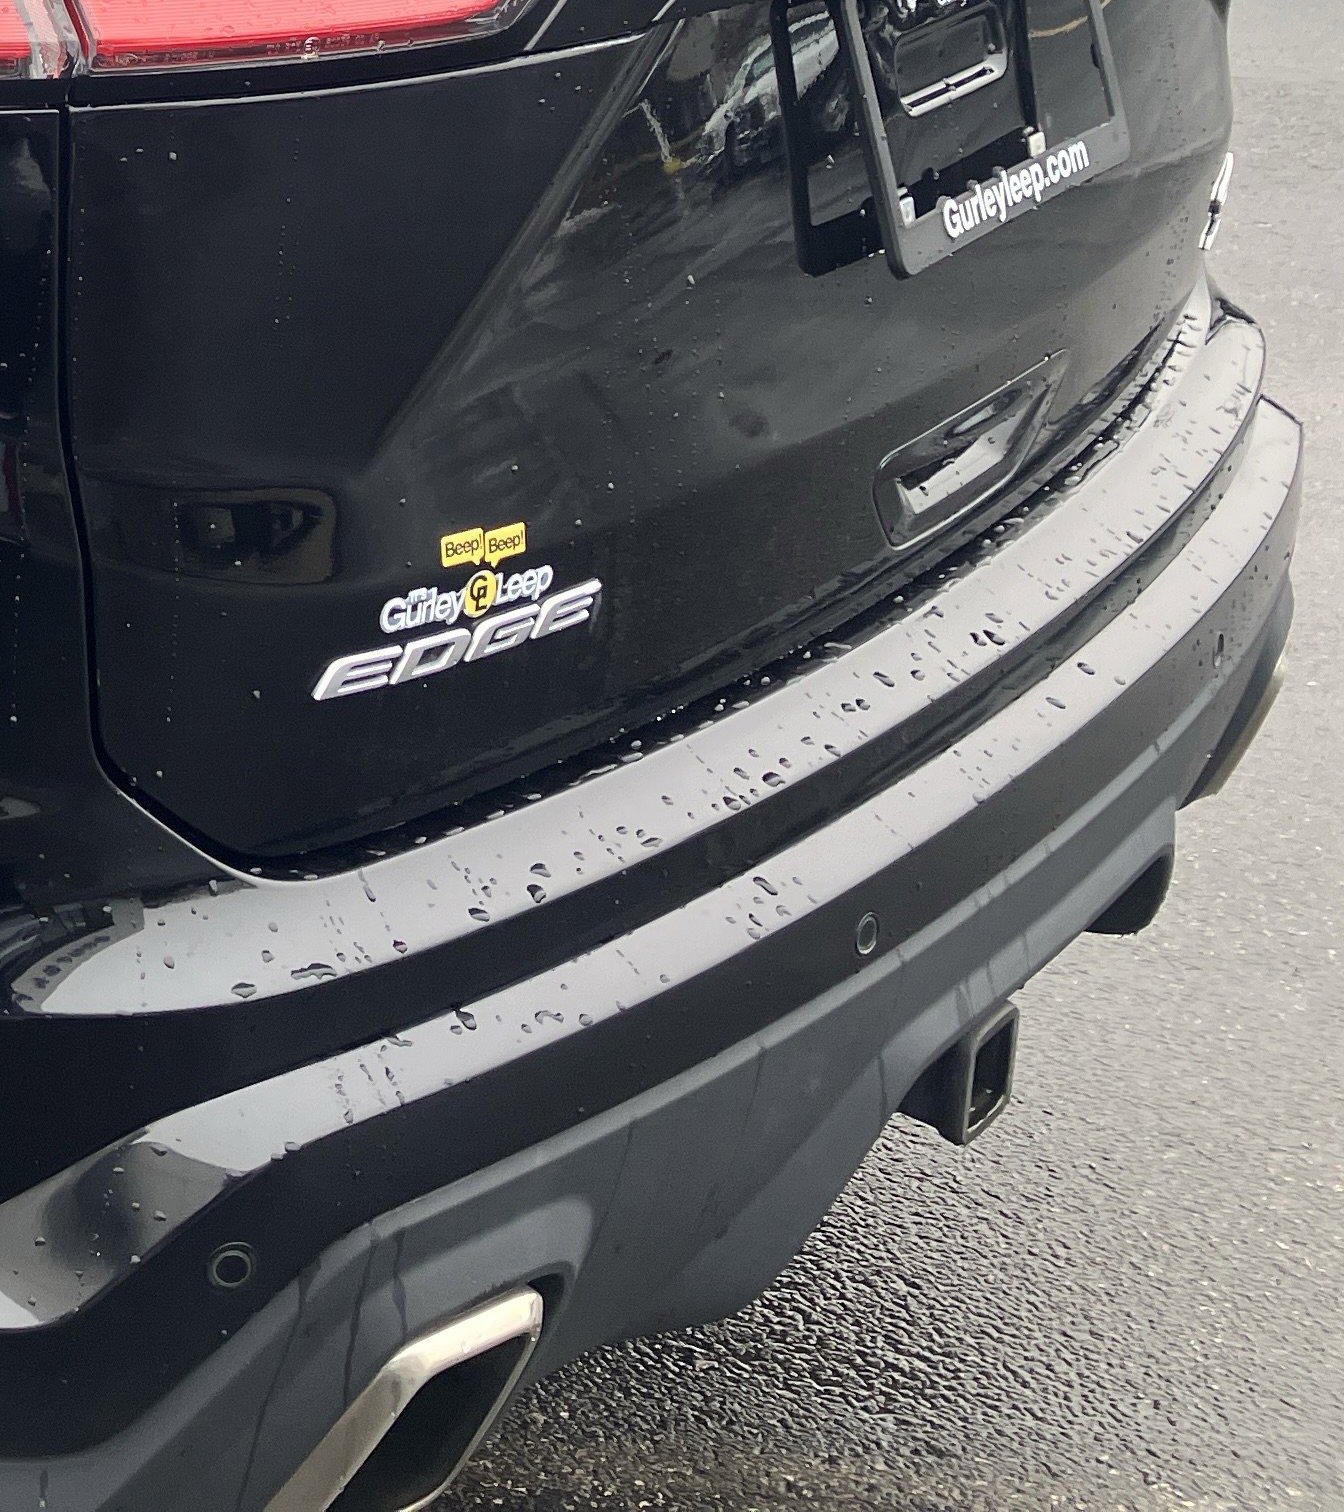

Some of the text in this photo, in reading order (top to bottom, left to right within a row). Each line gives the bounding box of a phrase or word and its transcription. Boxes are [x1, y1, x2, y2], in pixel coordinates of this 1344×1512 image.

[943, 140, 1090, 238] Gurleyleep.com
[445, 534, 483, 558] Beep!
[488, 529, 525, 554] Beep!
[381, 566, 553, 632] Gurley Leep
[312, 578, 602, 701] EDGE
